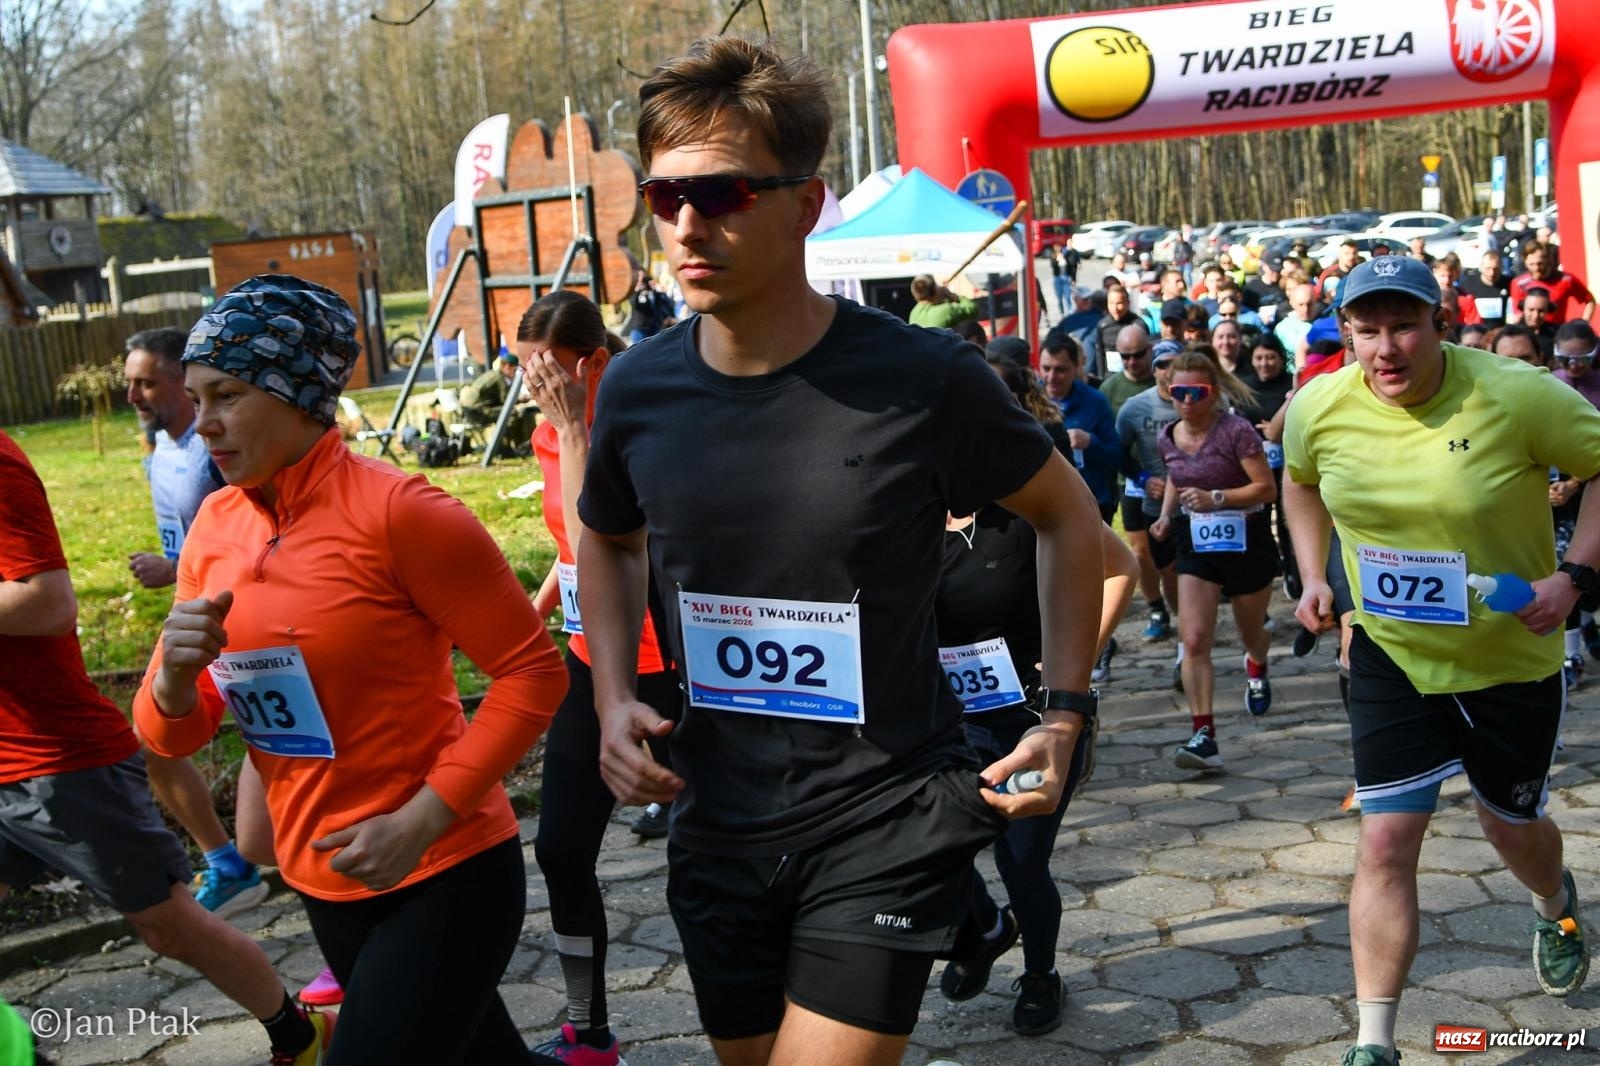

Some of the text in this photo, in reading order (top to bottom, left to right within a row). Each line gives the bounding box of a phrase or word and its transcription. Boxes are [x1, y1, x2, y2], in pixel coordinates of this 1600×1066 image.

[1248, 5, 1334, 29] BIEG
[1180, 31, 1415, 76] TWARDZIELA
[1202, 72, 1391, 112] RACIBÓRZ
[473, 143, 493, 198] RA
[160, 528, 176, 549] 57
[1199, 524, 1236, 540] 049
[1363, 549, 1457, 564] XIV BIEG TWARDZIELA
[1378, 572, 1446, 603] 072
[692, 602, 845, 624] XIV BIEG TWARDZIELA
[733, 618, 754, 626] 2026
[716, 636, 828, 688] 092
[956, 644, 1000, 659] TWARDZIELA
[229, 656, 295, 672] TWARDZIELA
[947, 665, 1000, 696] 035
[227, 689, 297, 730] 013
[873, 913, 913, 928] RITUAL
